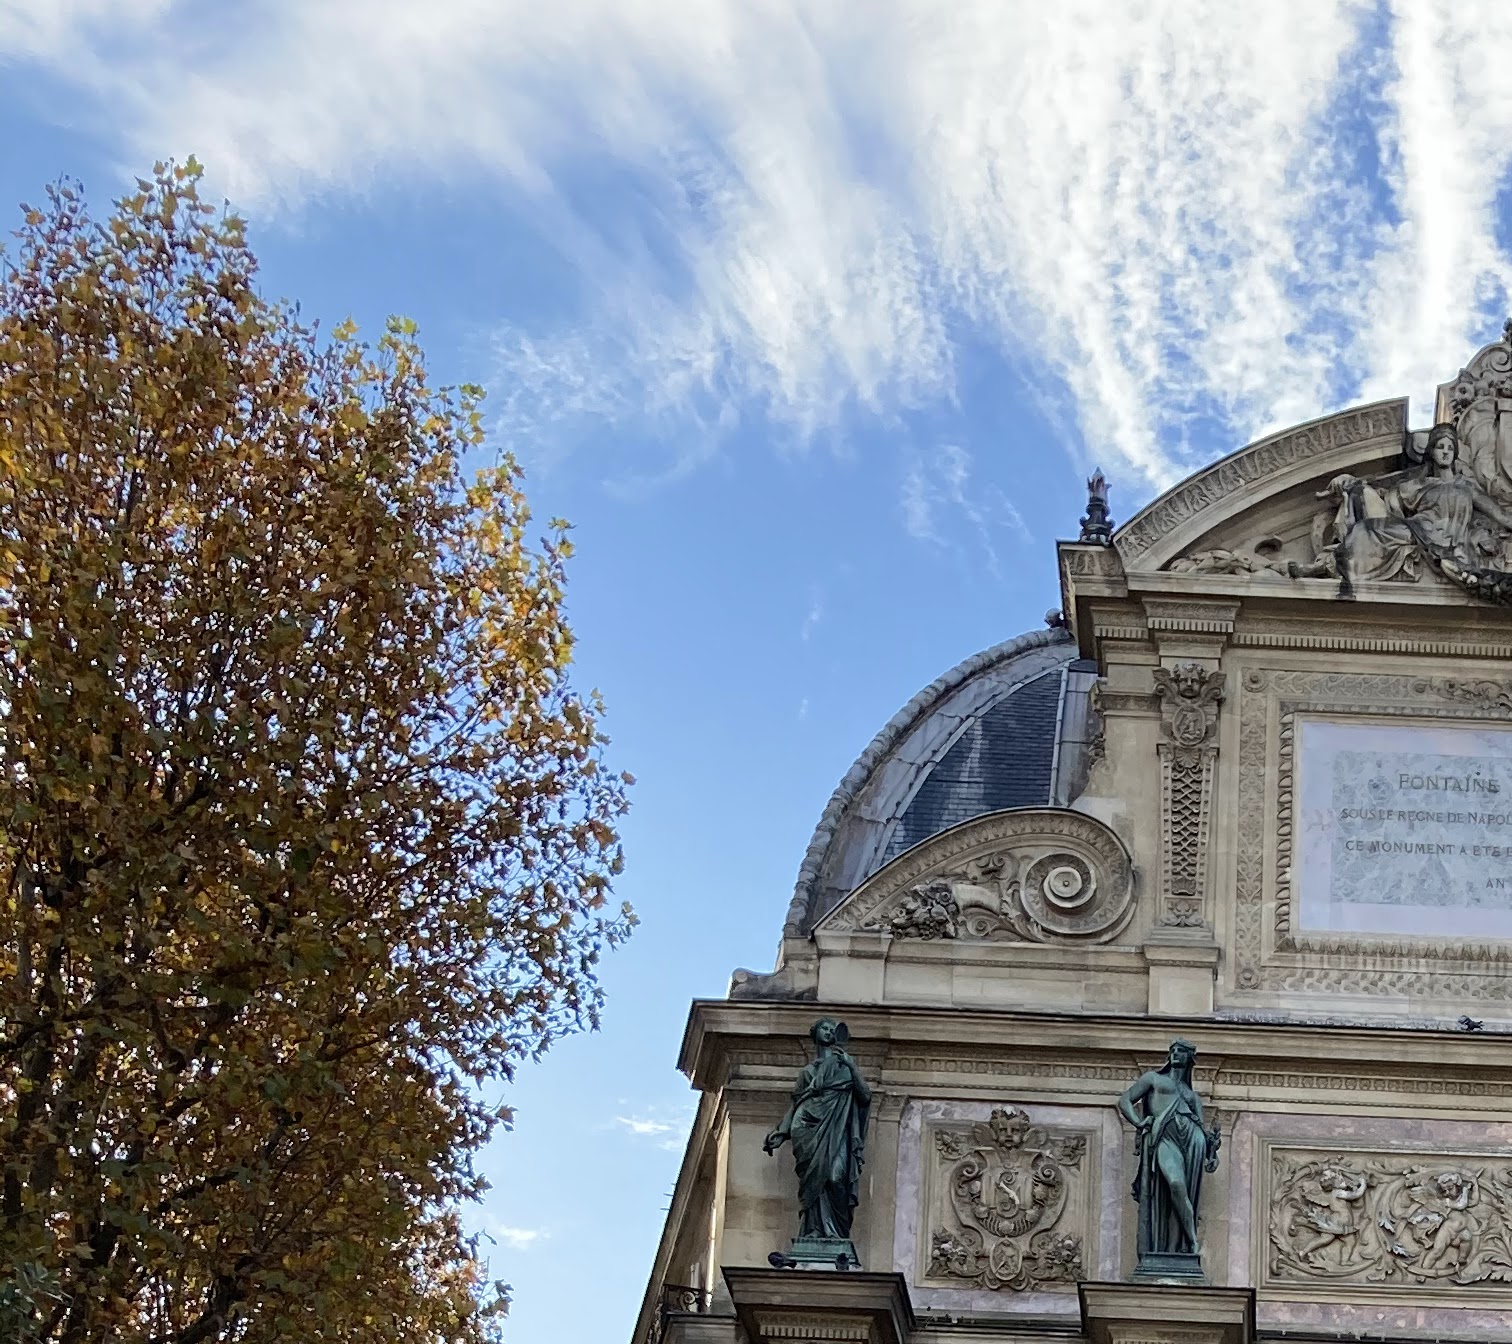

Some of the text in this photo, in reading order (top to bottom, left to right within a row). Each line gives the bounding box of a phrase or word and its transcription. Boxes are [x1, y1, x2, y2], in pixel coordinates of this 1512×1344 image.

[1398, 773, 1500, 793] FONTAINE
[1340, 808, 1375, 820] SOUS
[1379, 810, 1394, 820] LE
[1447, 812, 1464, 823] DE
[1345, 840, 1364, 851] CE
[1369, 841, 1455, 855] MONUMENT
[1459, 845, 1468, 856] A
[1485, 878, 1505, 889] AN
